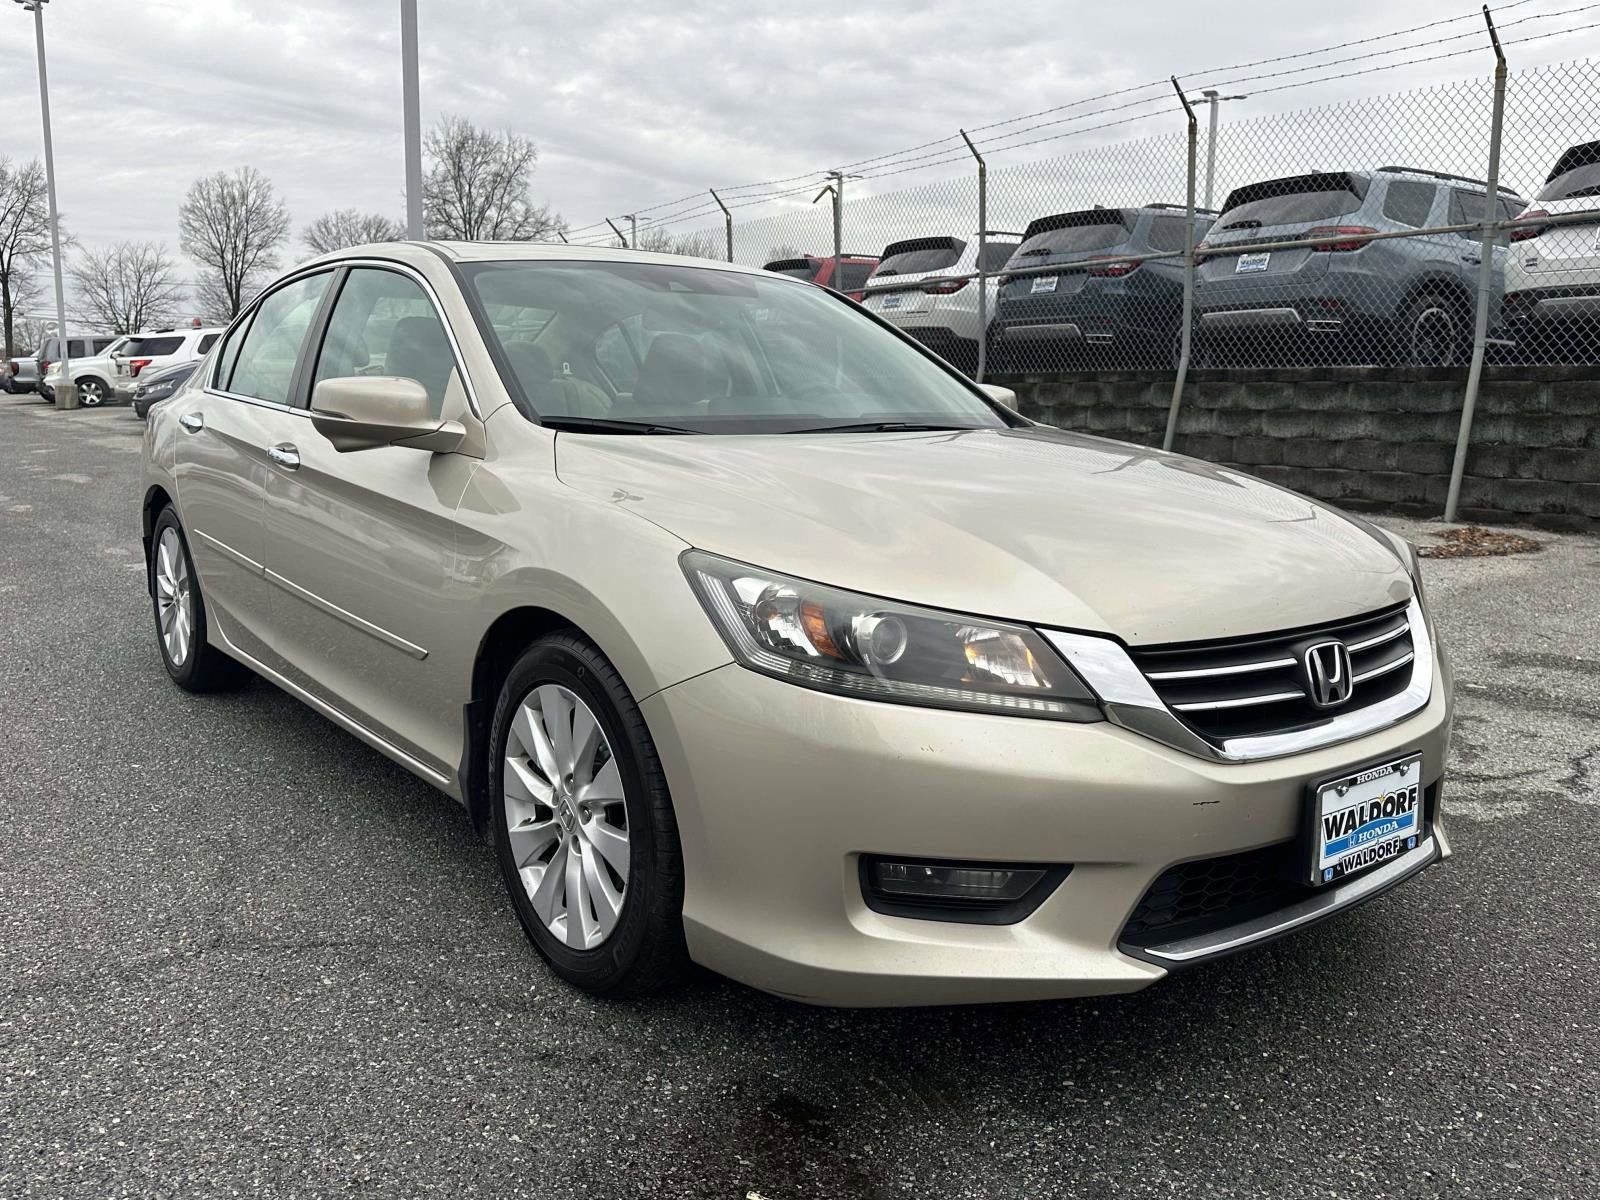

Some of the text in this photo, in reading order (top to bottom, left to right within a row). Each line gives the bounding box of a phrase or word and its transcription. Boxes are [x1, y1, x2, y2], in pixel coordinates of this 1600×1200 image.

[1357, 766, 1393, 784] HONDA
[1323, 786, 1418, 840] WALDORF
[1358, 820, 1399, 842] HONDA
[1343, 839, 1399, 873] WALDORF
